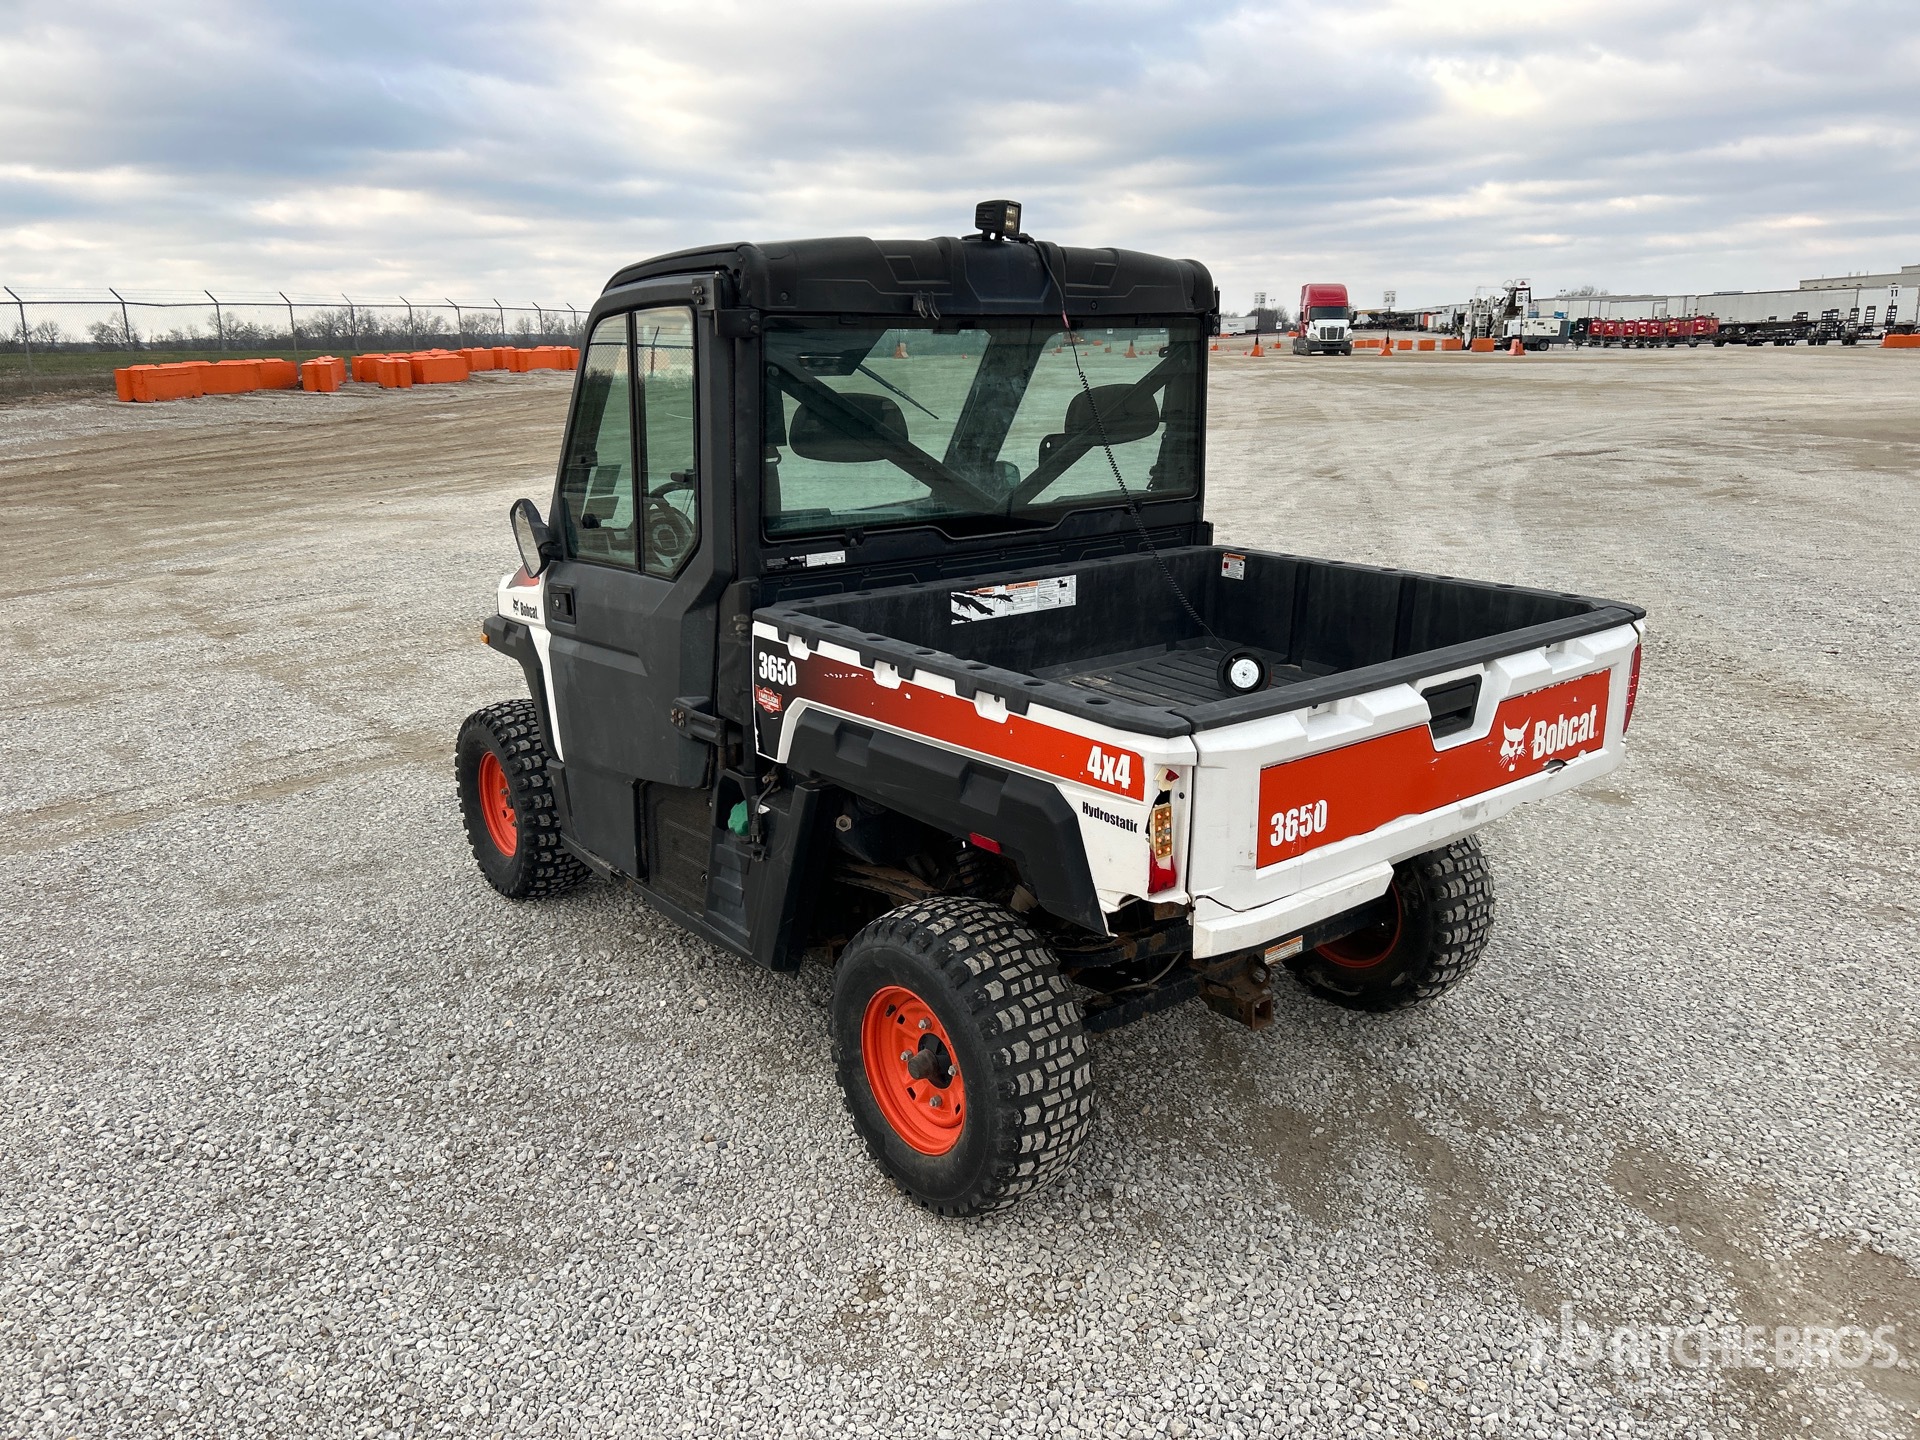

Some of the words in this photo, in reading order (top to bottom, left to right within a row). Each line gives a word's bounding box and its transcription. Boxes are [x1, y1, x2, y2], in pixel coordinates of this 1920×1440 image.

[520, 601, 539, 619] Bobcat
[758, 651, 797, 687] 3650
[1531, 704, 1597, 761] Bobcat
[1086, 745, 1132, 790] 4x4
[1270, 799, 1328, 848] 3650
